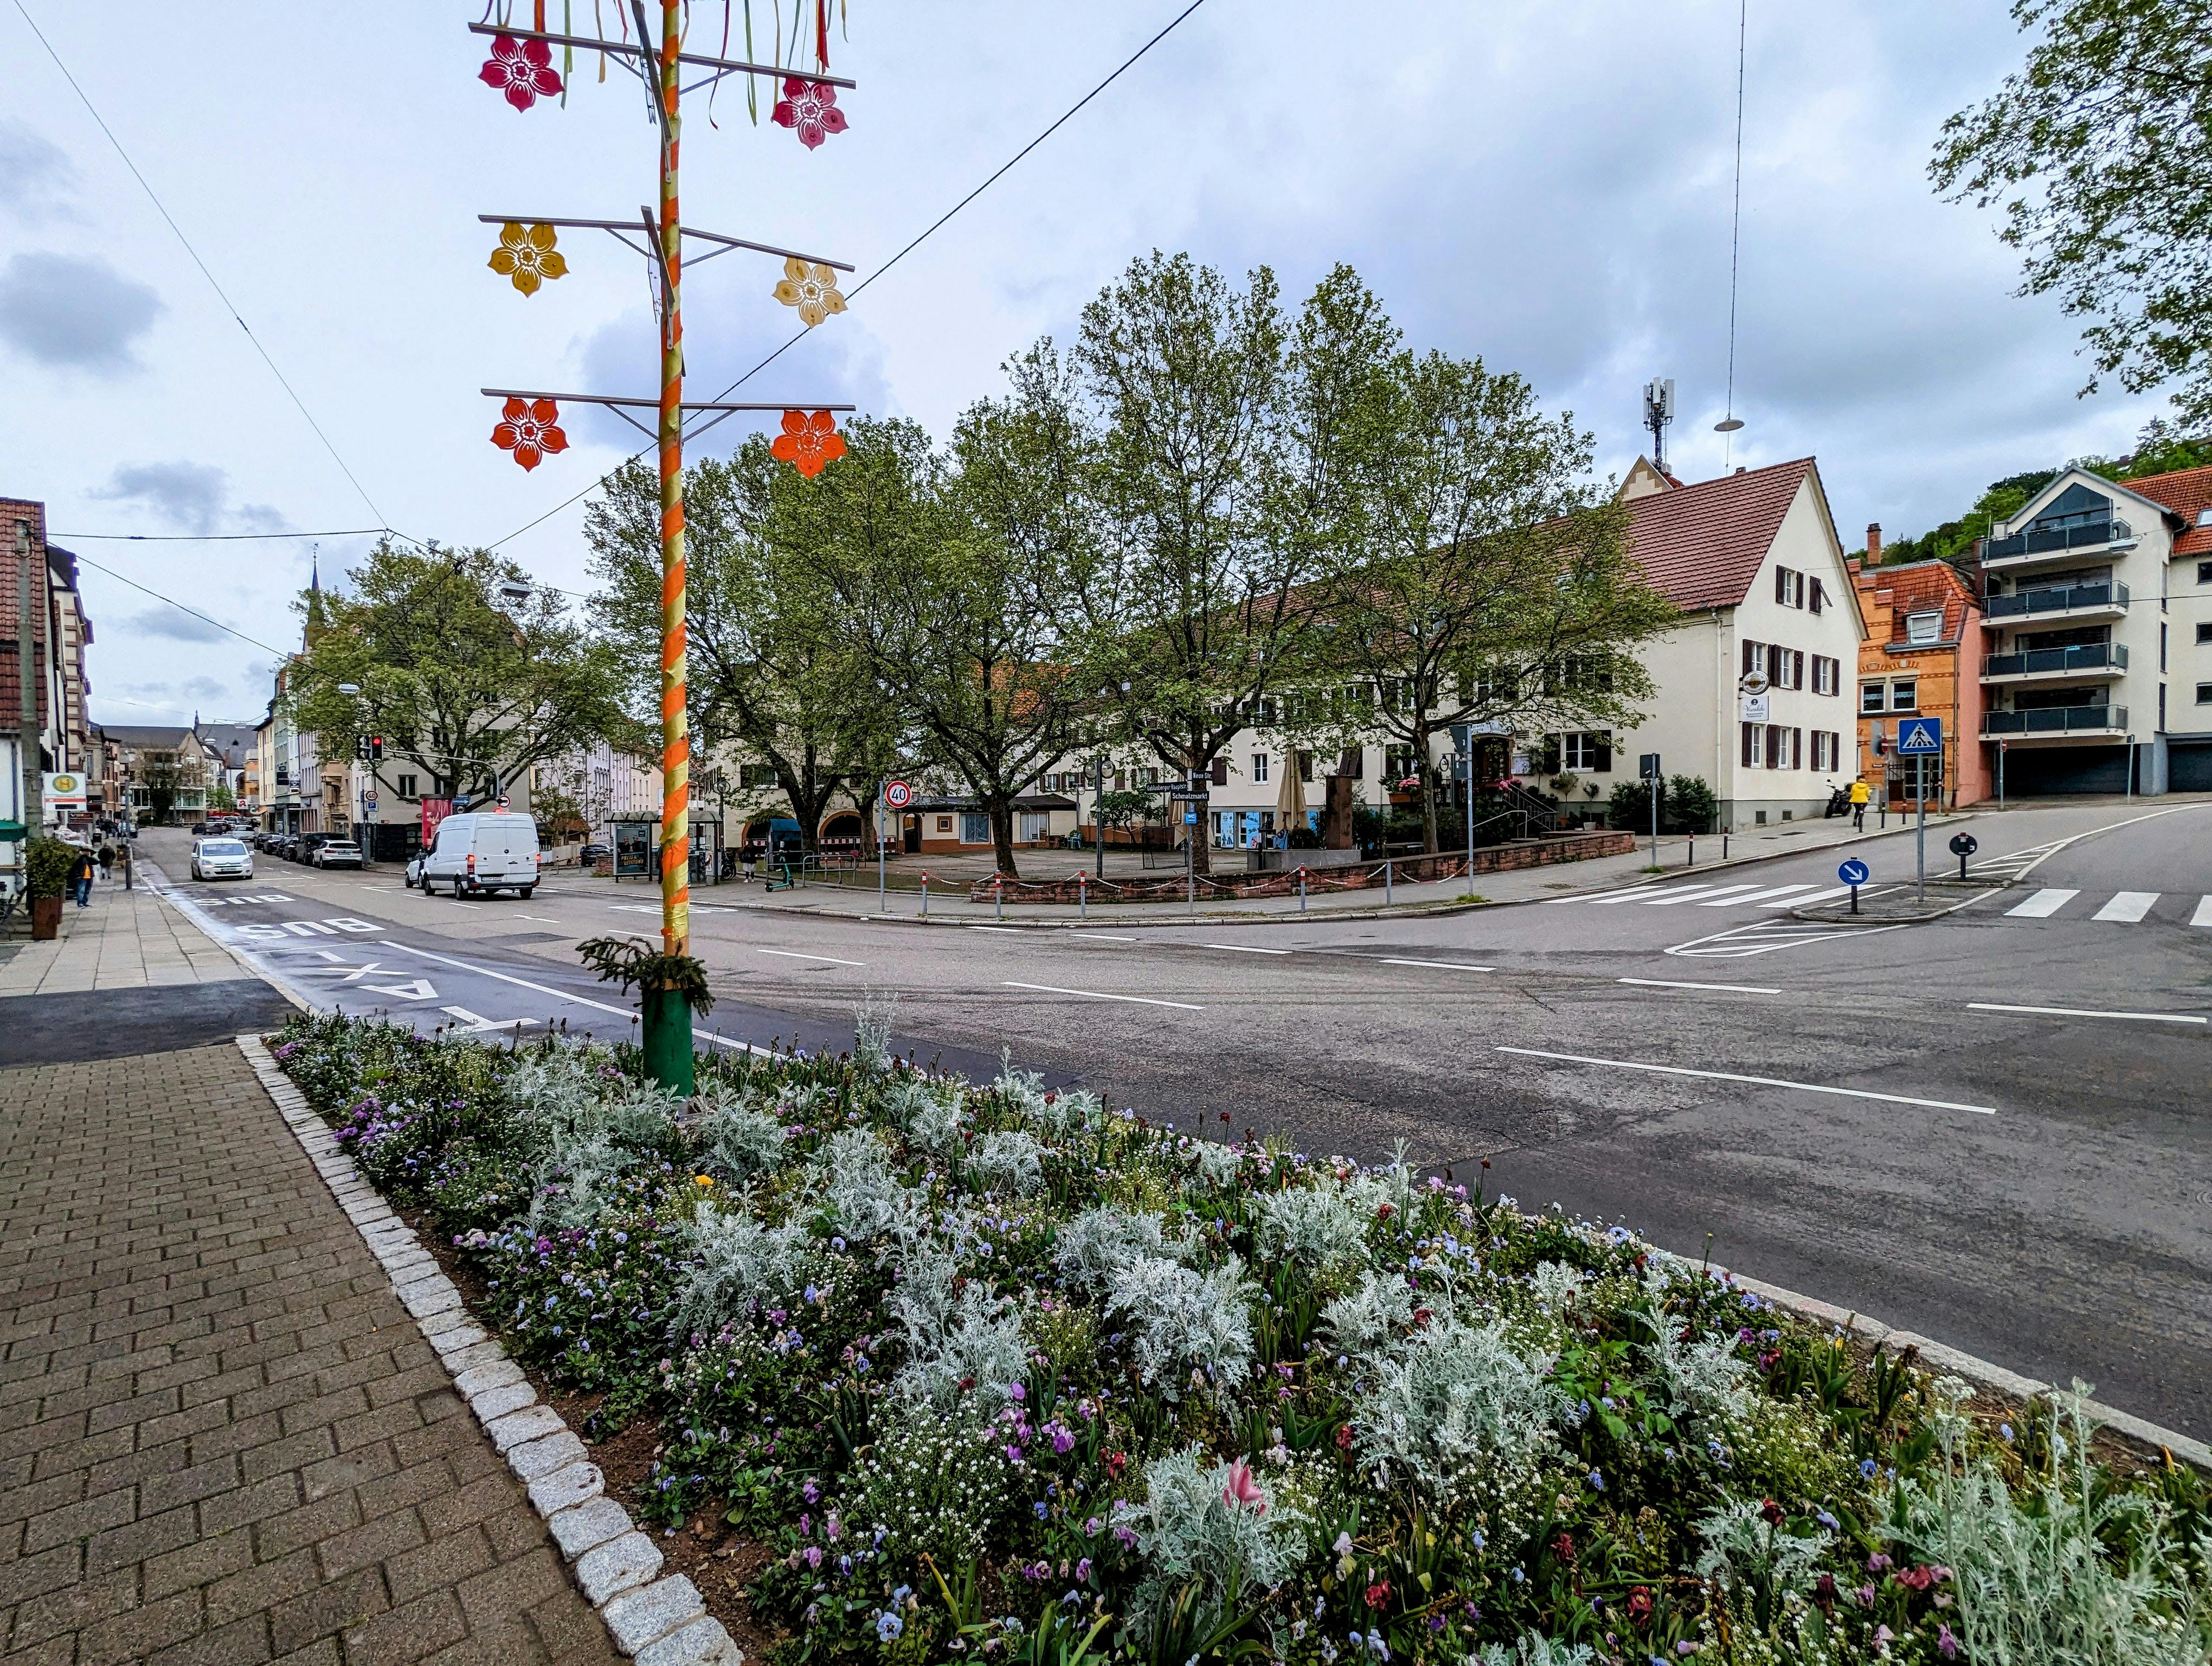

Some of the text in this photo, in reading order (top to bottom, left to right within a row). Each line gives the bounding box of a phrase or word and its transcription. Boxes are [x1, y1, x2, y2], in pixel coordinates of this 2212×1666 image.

[891, 789, 906, 800] 40
[193, 894, 296, 906] BUS
[235, 917, 387, 939] BUS
